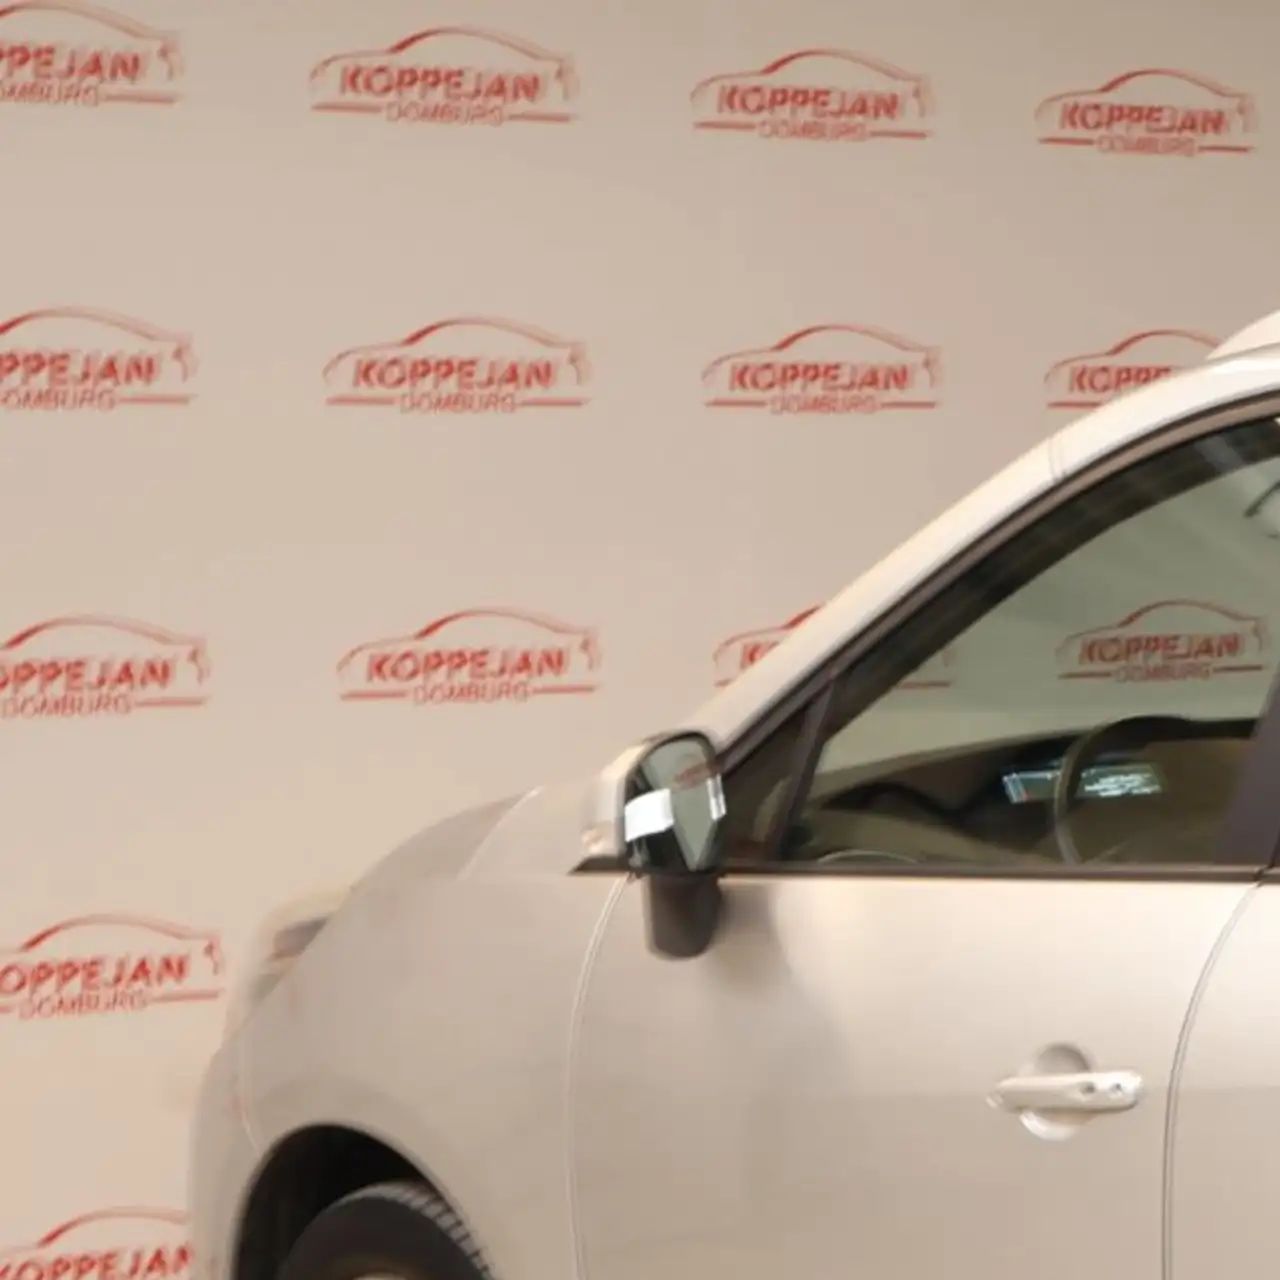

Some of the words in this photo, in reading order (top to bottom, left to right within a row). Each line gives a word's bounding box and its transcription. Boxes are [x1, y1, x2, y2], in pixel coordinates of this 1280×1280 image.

[340, 65, 542, 101] KOPPEJAN
[717, 85, 899, 119] KOPPEJAN
[1060, 101, 1226, 135] KOPPEJAN
[353, 358, 557, 389] KOPPEJAN
[729, 361, 910, 390] KOPPEJAN
[399, 391, 517, 414] DOMBURG
[1079, 633, 1240, 664] KOPPEJAN
[0, 657, 172, 693] PPEJAN
[367, 648, 565, 682] KOPPEJAN
[414, 680, 531, 705] DOMBURG
